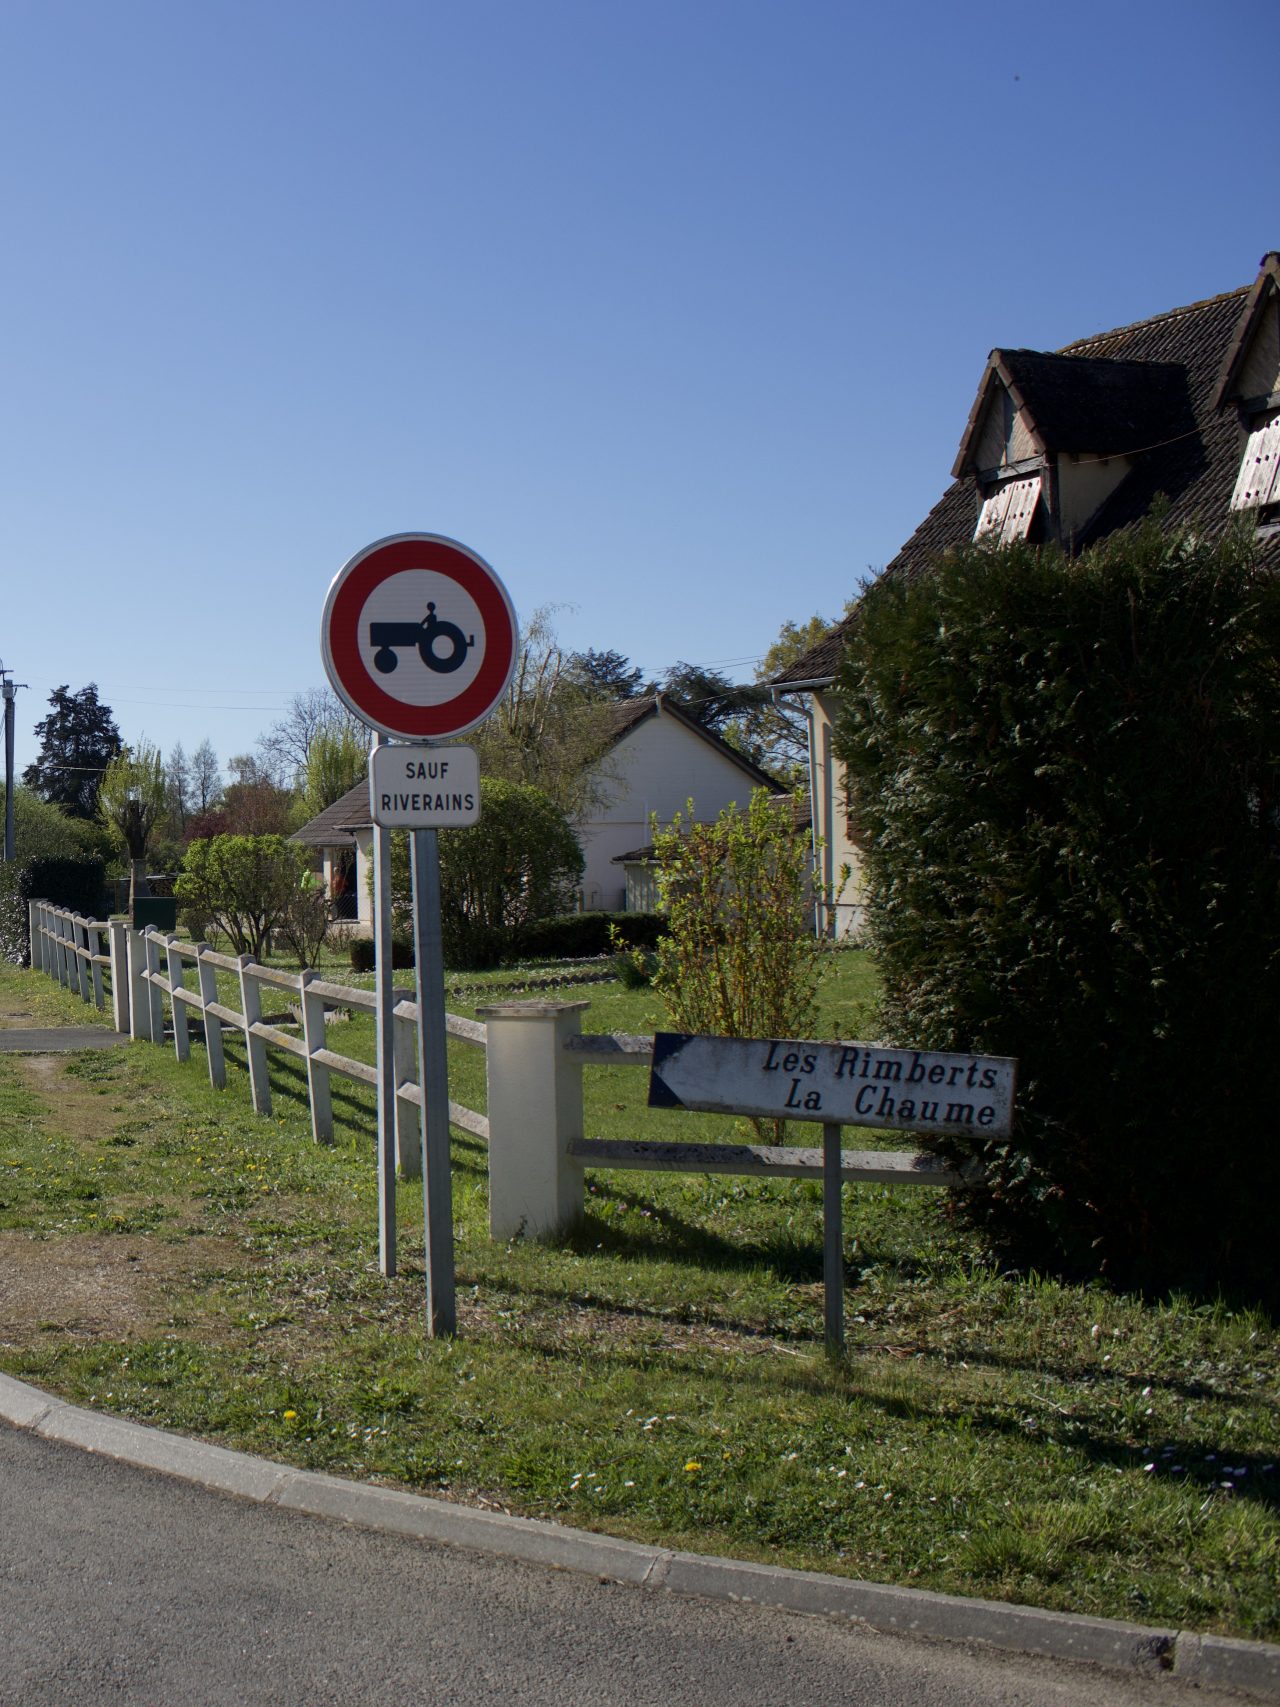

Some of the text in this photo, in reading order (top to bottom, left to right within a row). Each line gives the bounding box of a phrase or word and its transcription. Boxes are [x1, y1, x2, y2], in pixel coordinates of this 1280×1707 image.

[406, 762, 449, 779] SAUF
[381, 794, 474, 811] RIVERAINS
[762, 1042, 997, 1089] Les Rimberts
[784, 1078, 996, 1126] La Chaume
